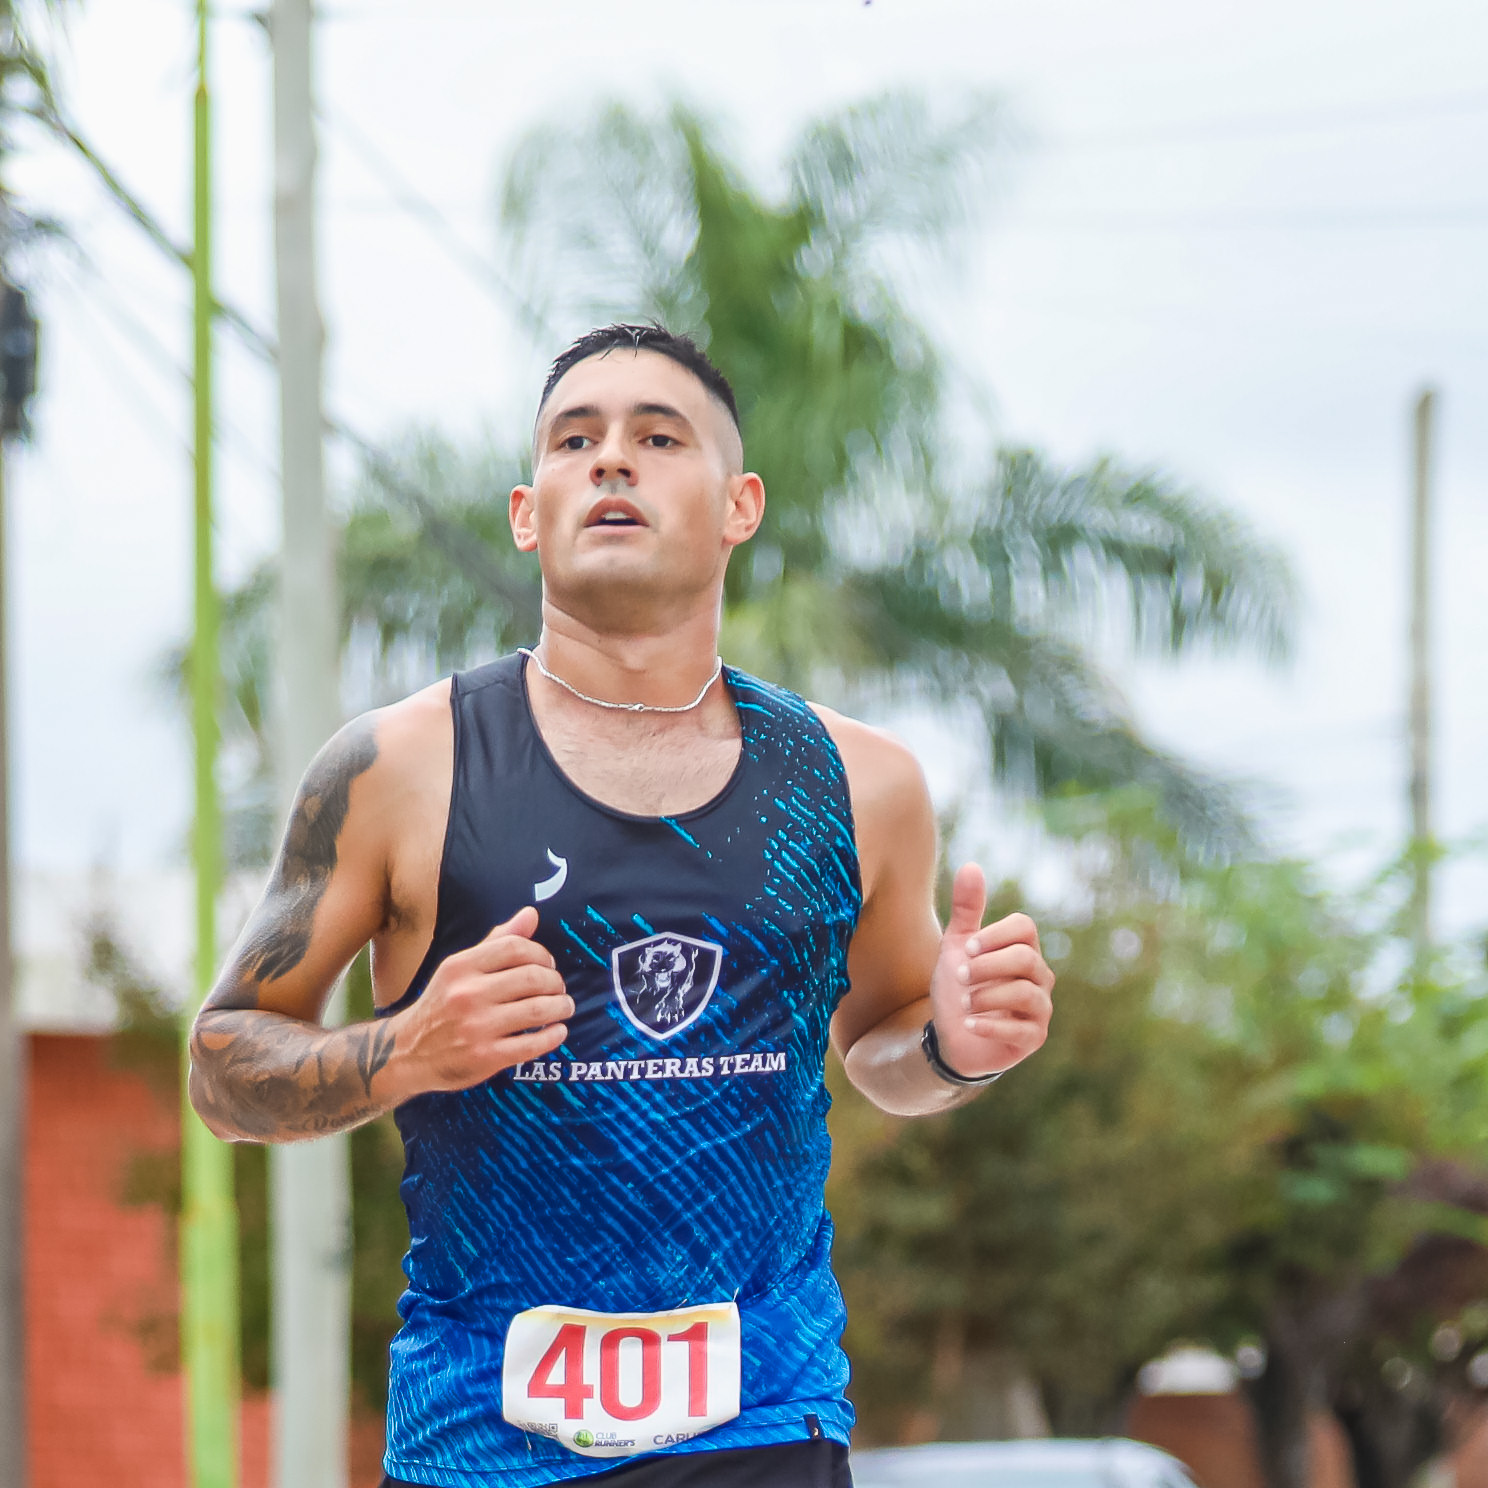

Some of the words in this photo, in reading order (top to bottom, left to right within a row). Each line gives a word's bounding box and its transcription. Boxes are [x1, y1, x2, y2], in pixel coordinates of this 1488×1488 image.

[513, 1061, 562, 1081] LAS
[569, 1057, 714, 1081] PANTERAS
[720, 1052, 786, 1075] TEAM
[527, 1321, 709, 1421] 401
